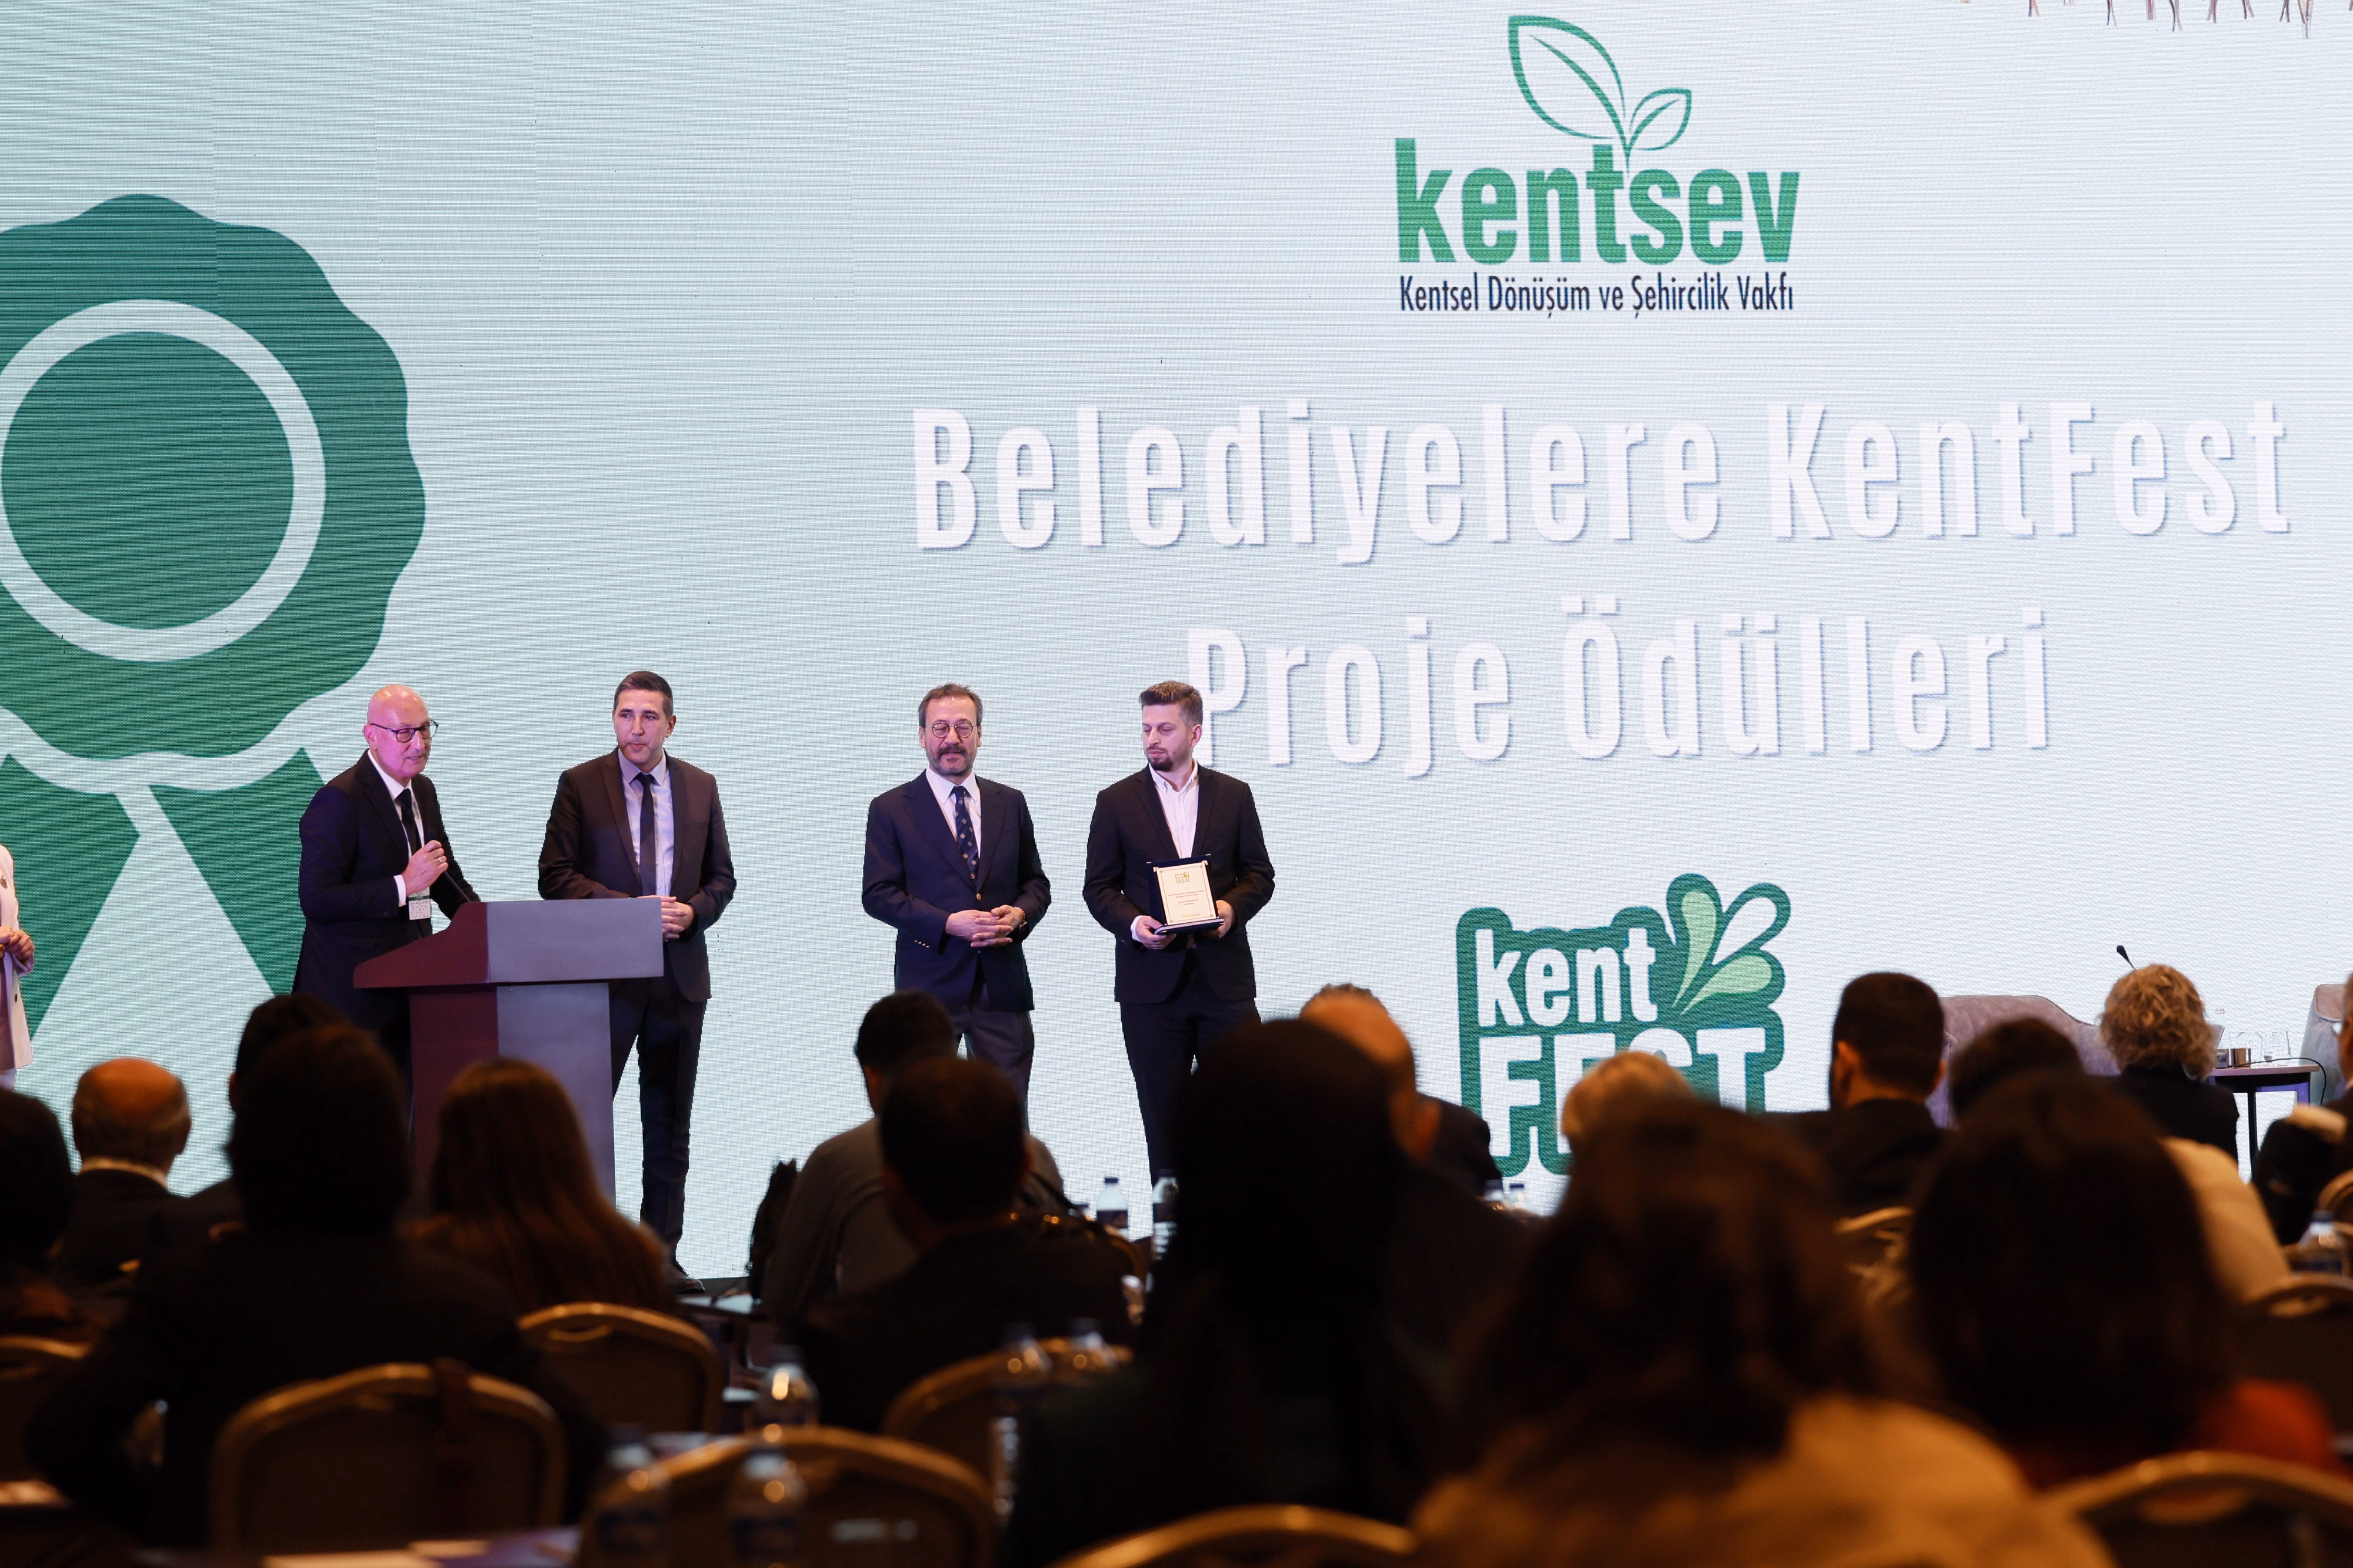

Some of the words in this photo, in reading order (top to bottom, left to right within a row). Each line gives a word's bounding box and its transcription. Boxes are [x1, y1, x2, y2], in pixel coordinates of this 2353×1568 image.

[1395, 138, 1801, 265] kentsev
[1400, 272, 1478, 311] Kentsel
[1488, 275, 1590, 319] Dönüşüm
[1598, 286, 1624, 311] ve
[1631, 272, 1729, 318] Şehircilik
[1737, 272, 1793, 310] Vakfı
[913, 398, 1721, 566] Belediyelere
[1766, 400, 2290, 540] KentFest
[1187, 616, 1512, 778] Proje
[1561, 593, 2049, 760] Ödülleri
[1475, 928, 1658, 1027] kent
